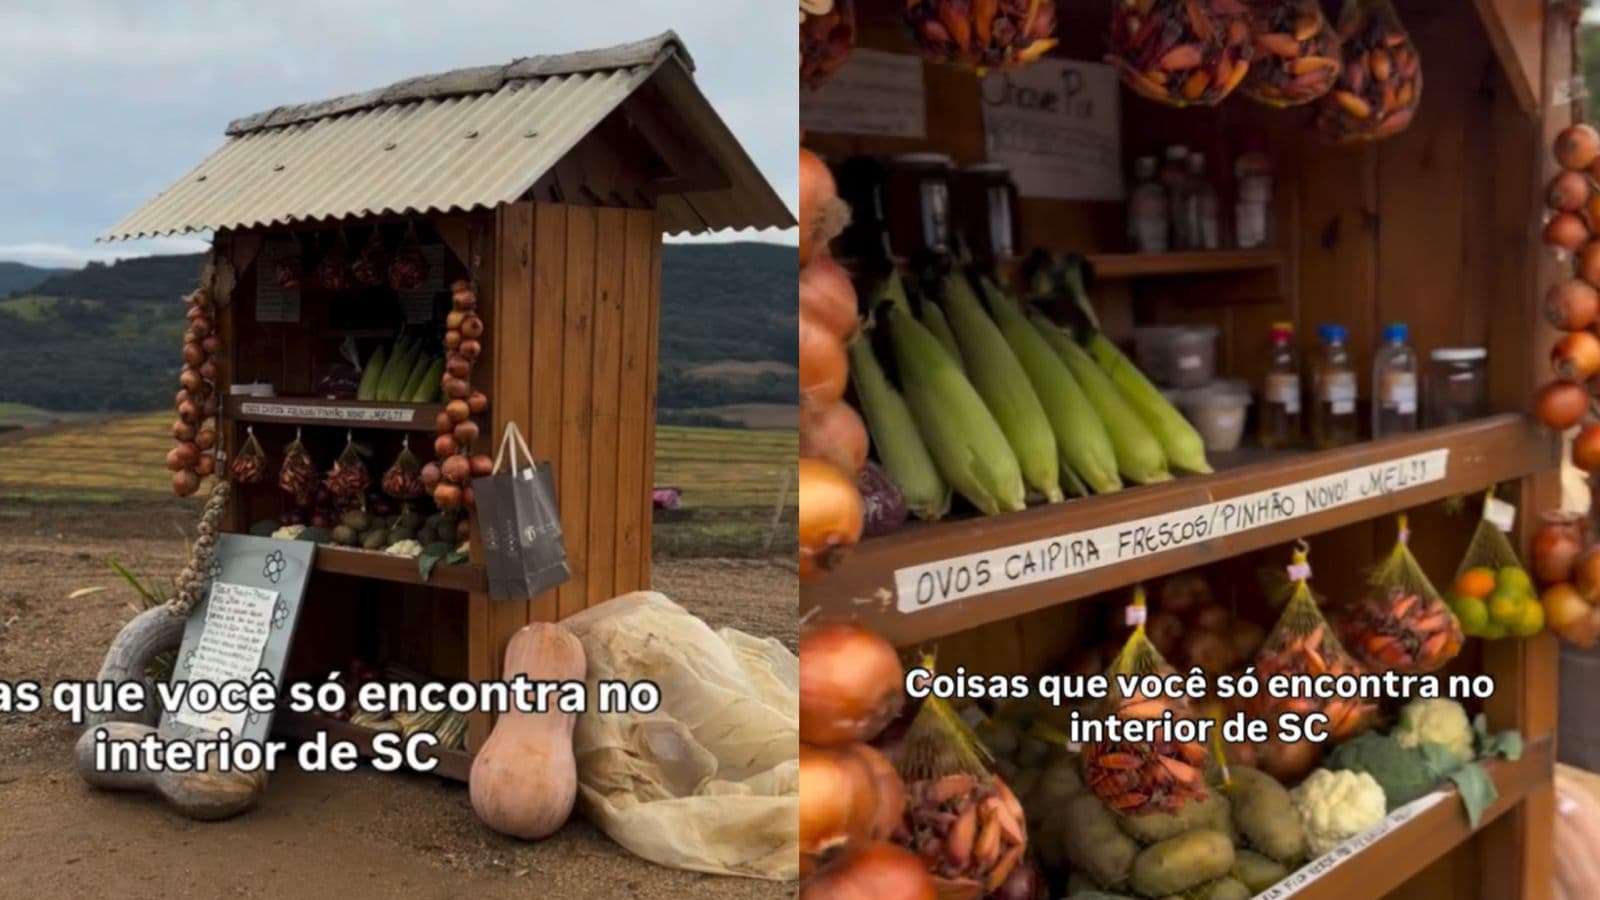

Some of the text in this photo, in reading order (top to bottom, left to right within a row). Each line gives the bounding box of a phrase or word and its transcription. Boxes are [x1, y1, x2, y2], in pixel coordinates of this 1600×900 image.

[915, 559, 992, 606] OVOS
[1003, 538, 1100, 581] CAIPIRA
[1304, 479, 1349, 513] NOVO!
